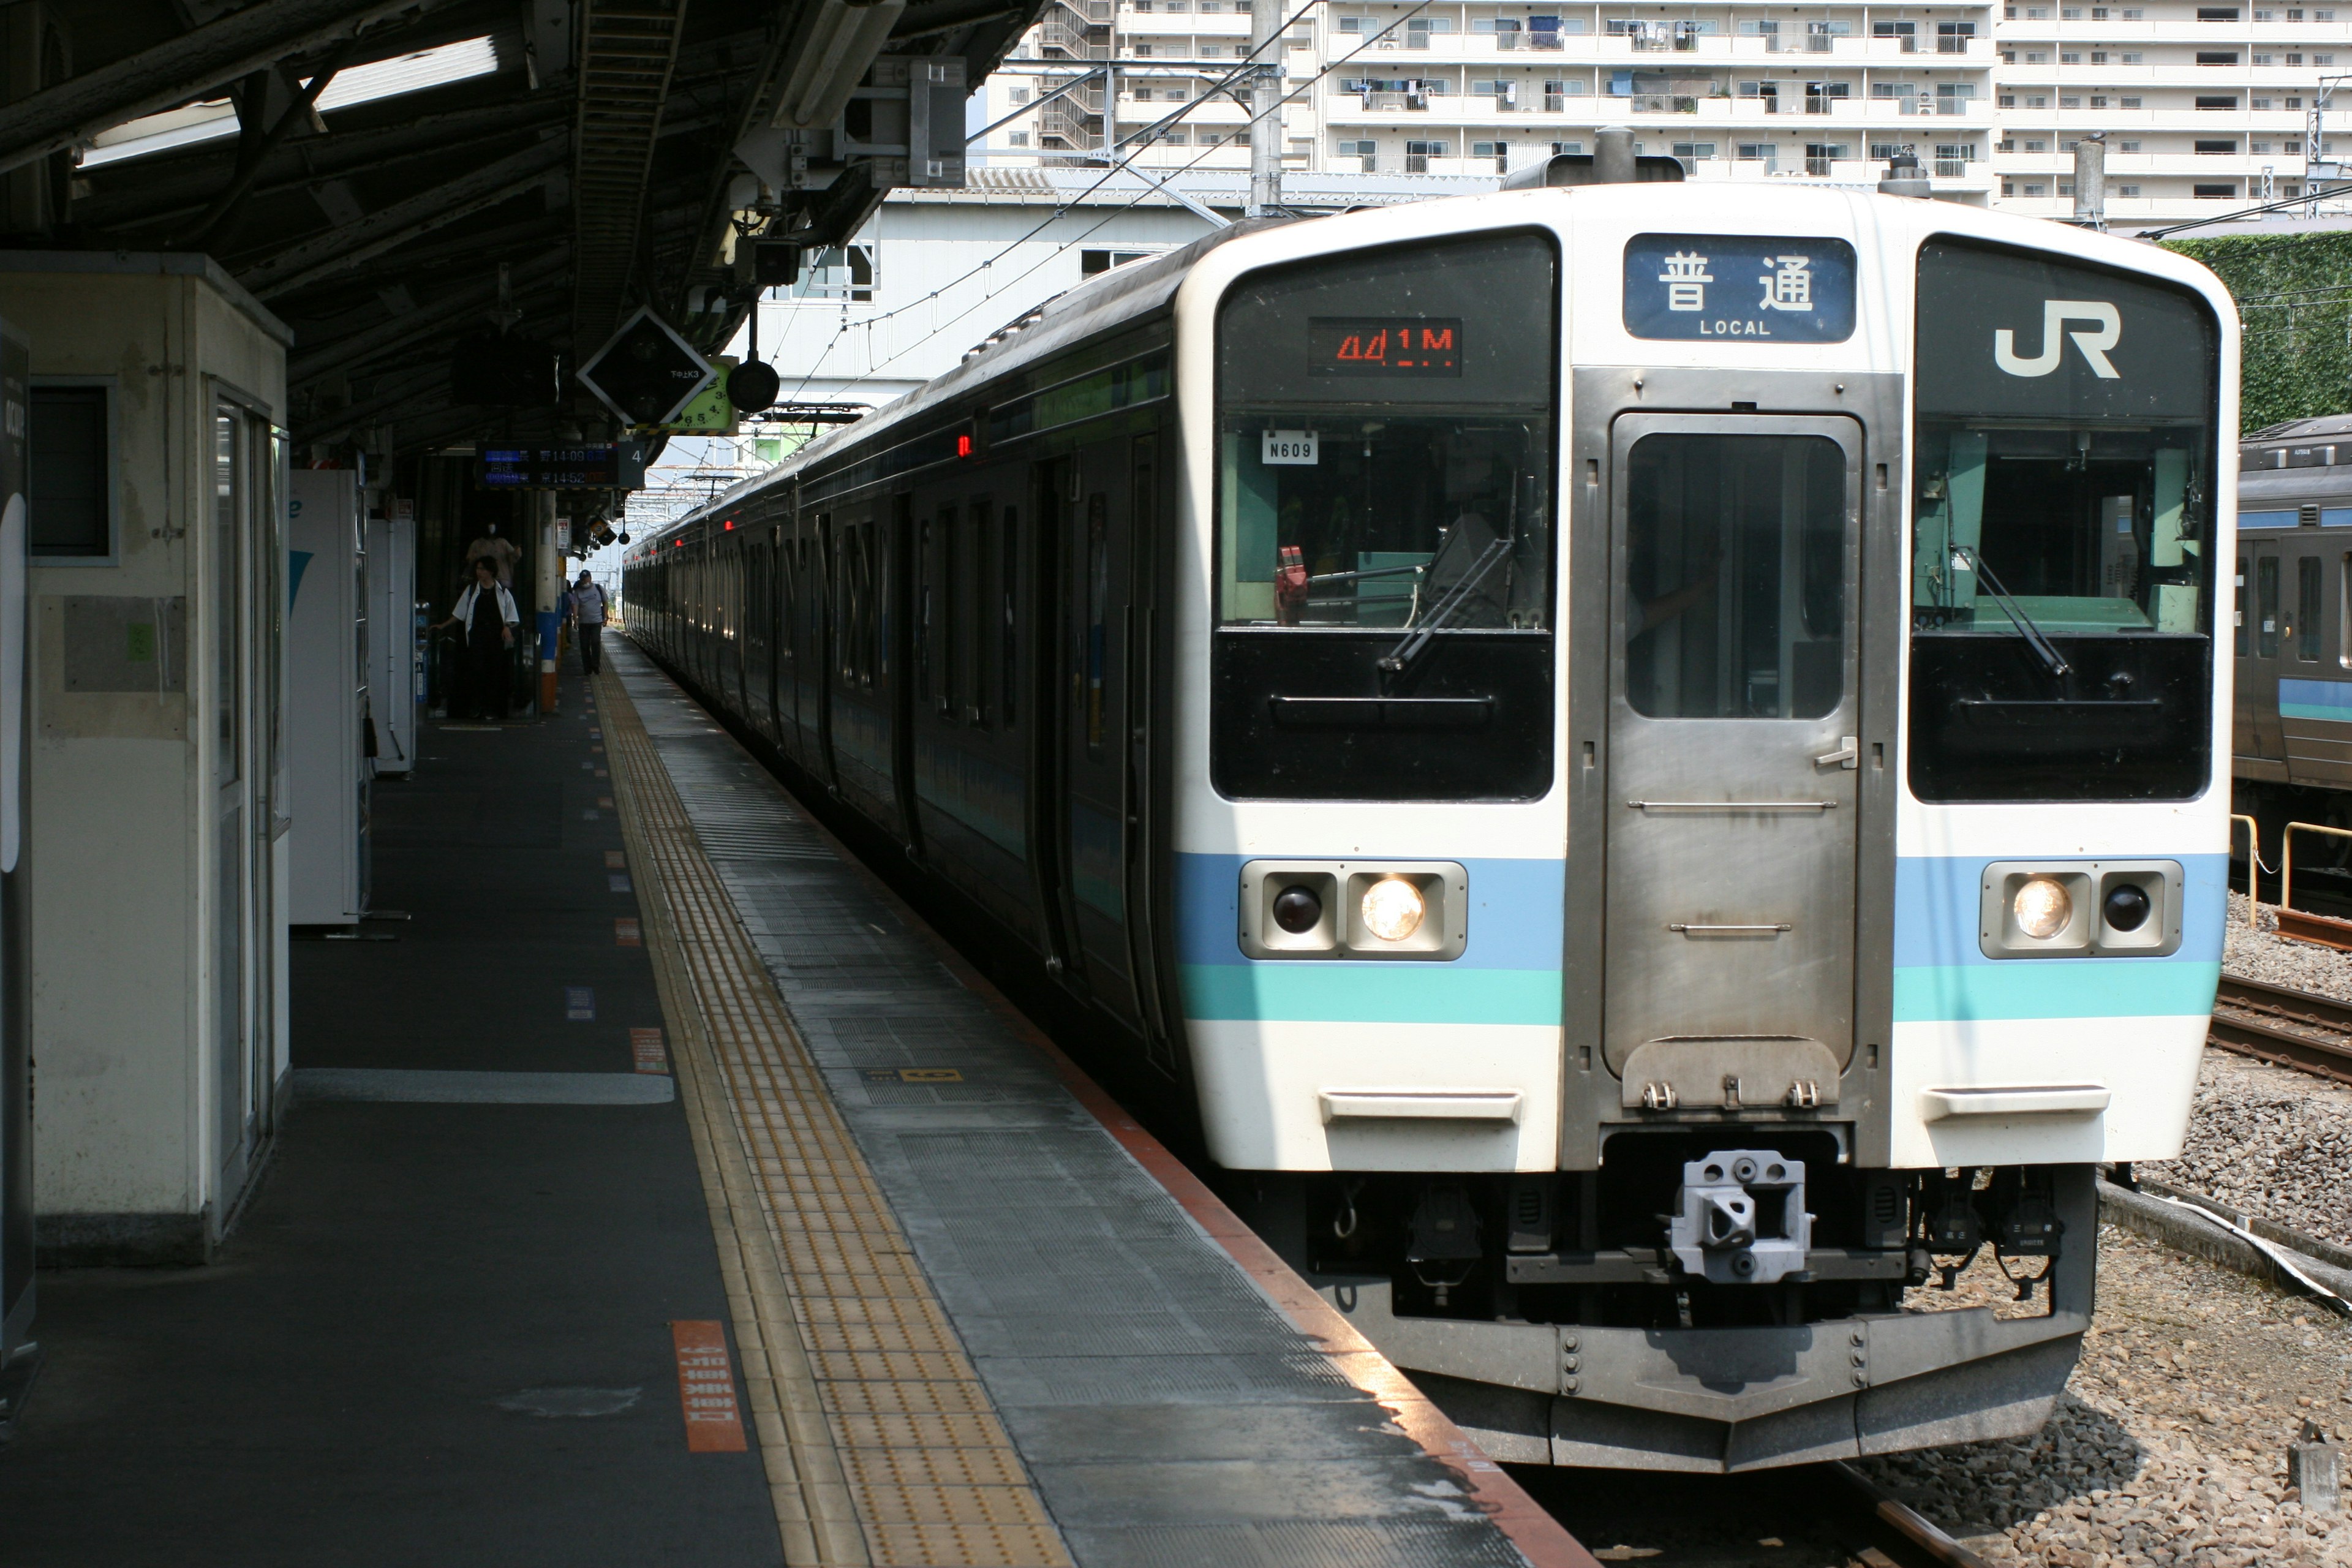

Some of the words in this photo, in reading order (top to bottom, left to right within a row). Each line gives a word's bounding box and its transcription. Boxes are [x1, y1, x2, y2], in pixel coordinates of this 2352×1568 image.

[1658, 251, 1814, 313] 普通
[1700, 319, 1771, 336] LOCAL
[1994, 300, 2121, 379] JR
[715, 391, 723, 400] 3
[552, 451, 584, 461] 14:09
[631, 450, 641, 462] 4
[1270, 443, 1311, 458] N609
[552, 472, 585, 483] 14:52
